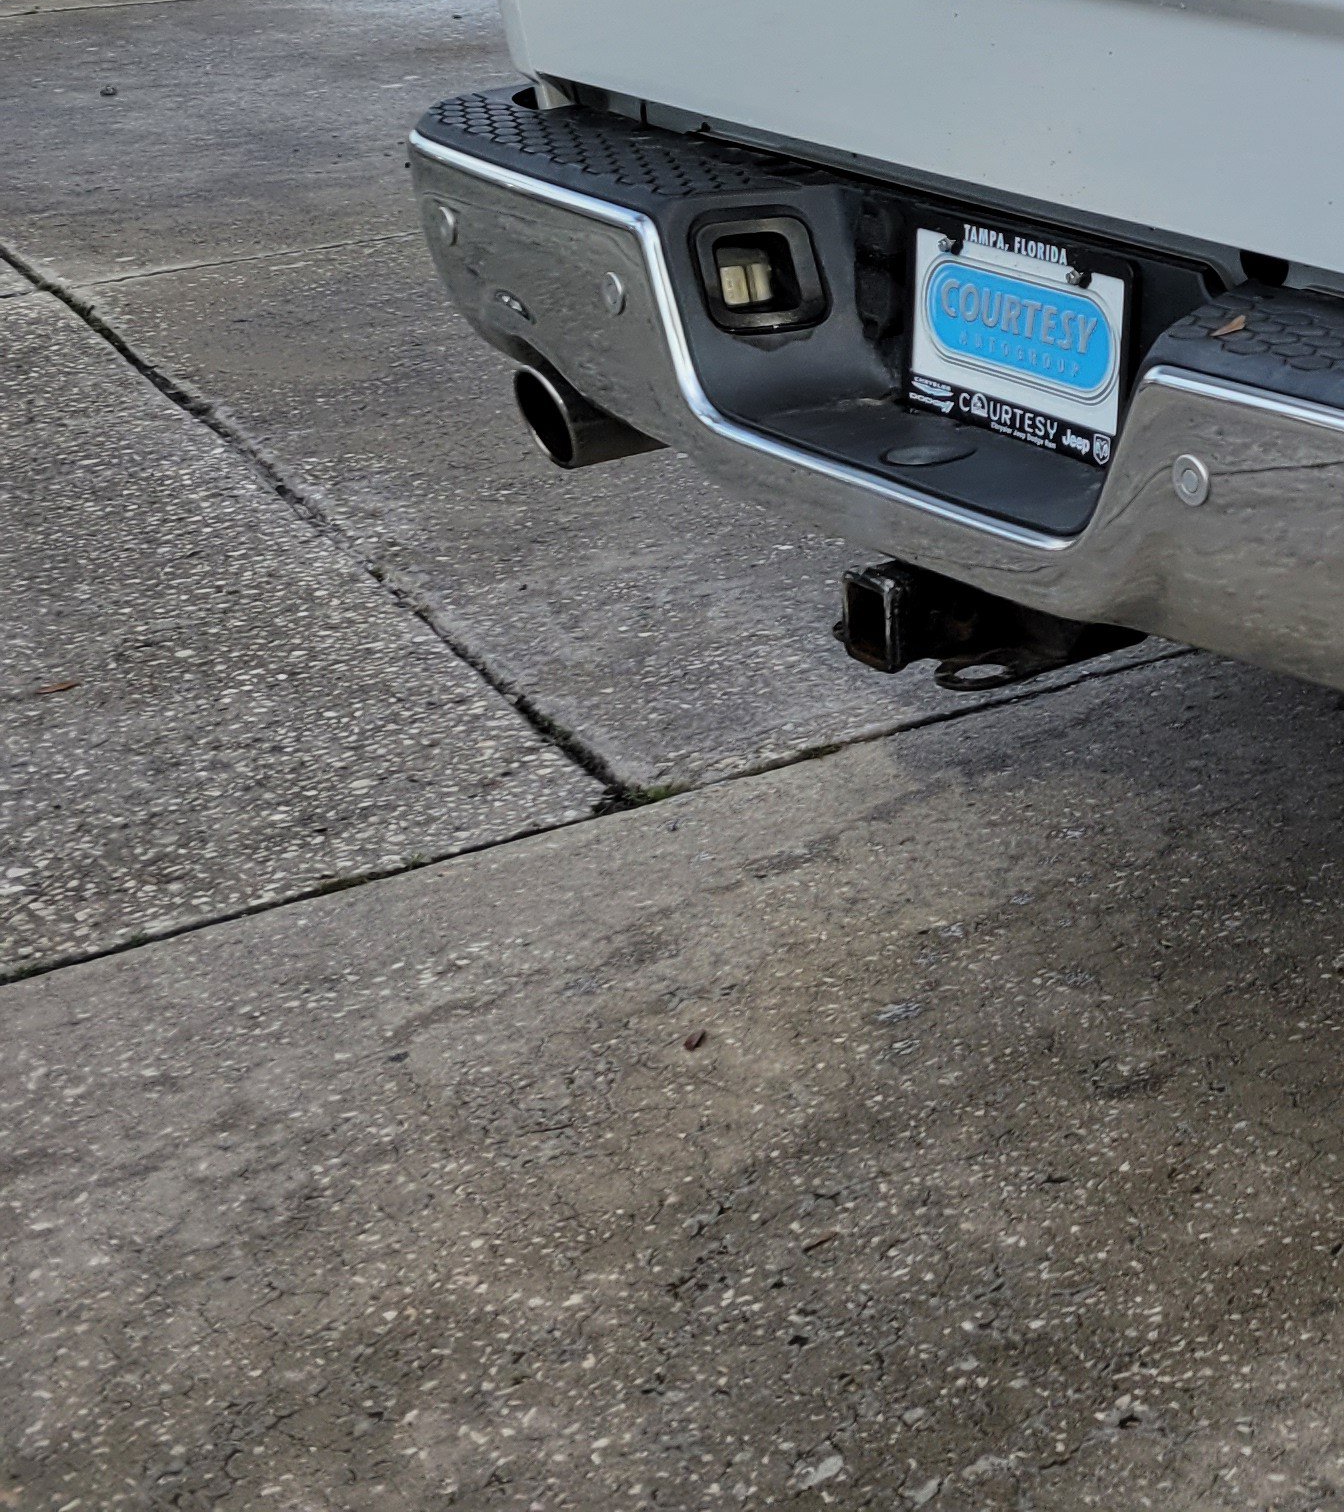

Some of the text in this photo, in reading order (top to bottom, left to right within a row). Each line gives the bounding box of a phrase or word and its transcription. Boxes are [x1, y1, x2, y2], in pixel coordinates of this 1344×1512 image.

[963, 224, 1069, 266] TAMPA, FLORIDA
[939, 278, 1099, 355] COURTESY
[1061, 429, 1090, 455] Jeep
